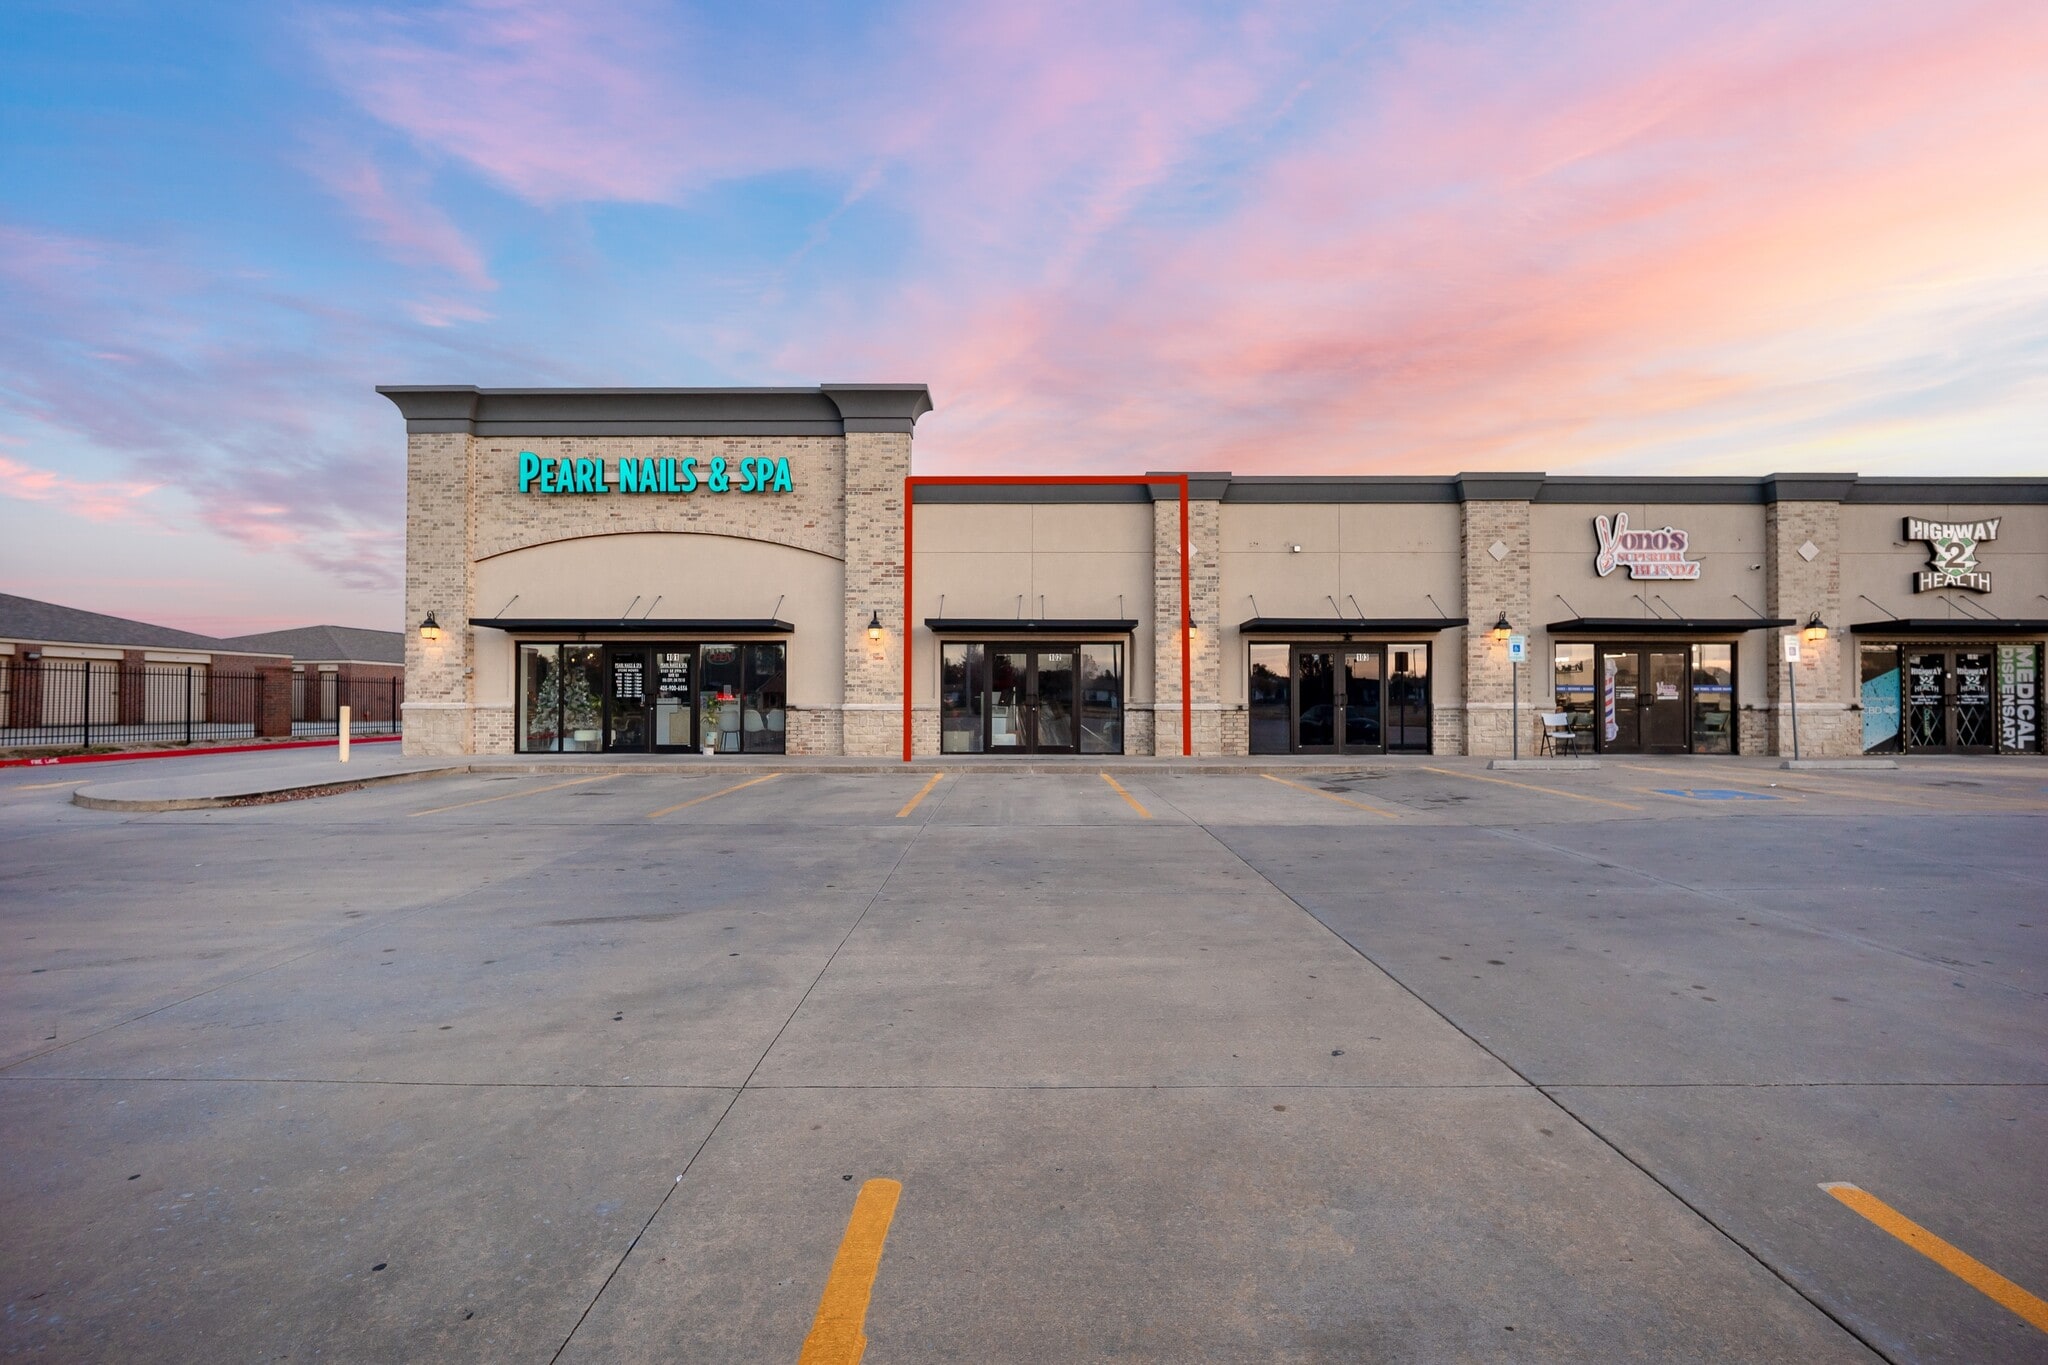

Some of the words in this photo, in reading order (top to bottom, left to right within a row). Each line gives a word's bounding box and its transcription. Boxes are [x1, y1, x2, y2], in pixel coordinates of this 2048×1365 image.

[519, 451, 609, 493] PEARL
[619, 457, 697, 493] NAILS
[708, 456, 729, 492] &
[740, 457, 793, 493] SPA
[1908, 518, 2000, 540] HIGHWAY
[1944, 541, 1966, 569] 2
[1920, 572, 1991, 592] HEALTH
[1049, 653, 1062, 661] 102
[1356, 653, 1370, 661] 103
[2001, 647, 2016, 749] DISPENSARY
[2016, 647, 2035, 749] MEDICAL
